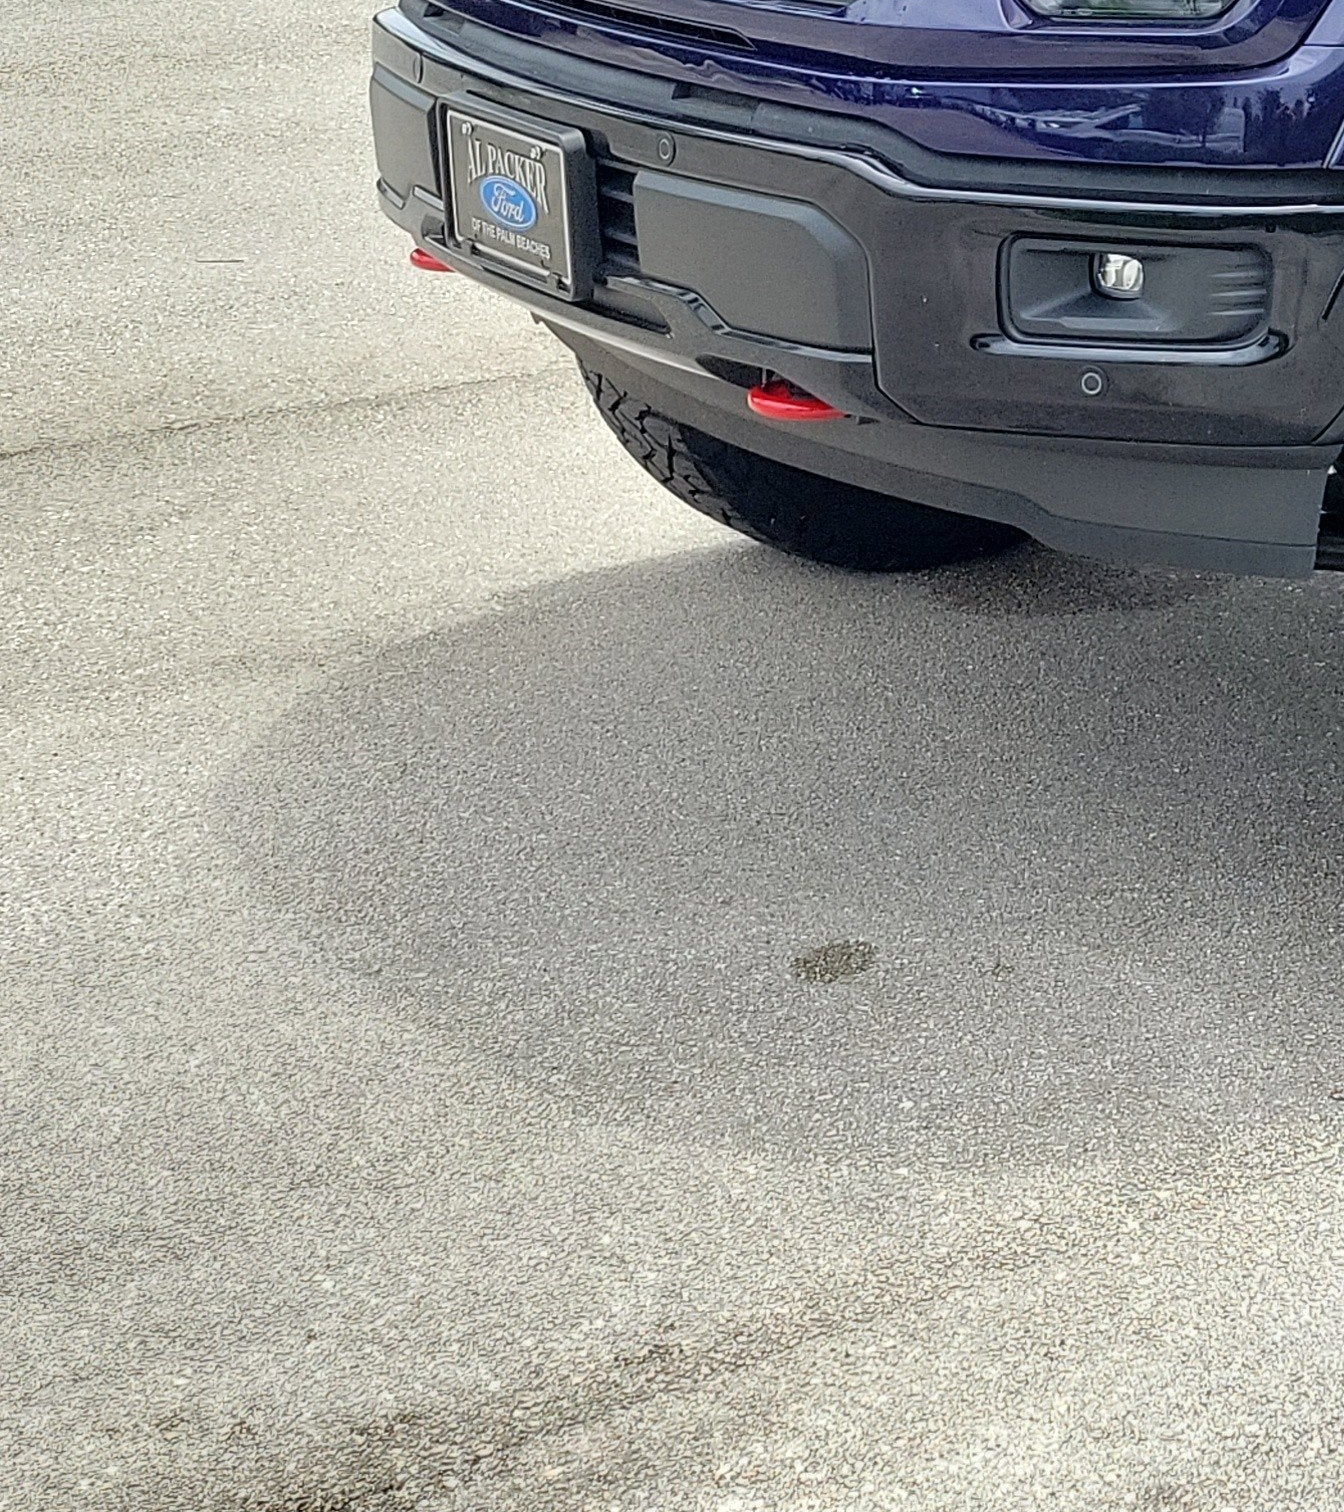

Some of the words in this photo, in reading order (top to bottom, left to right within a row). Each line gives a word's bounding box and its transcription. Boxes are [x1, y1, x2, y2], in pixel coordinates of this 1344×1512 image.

[467, 136, 487, 183] AL
[487, 142, 550, 216] PACKER
[491, 182, 525, 223] Ford
